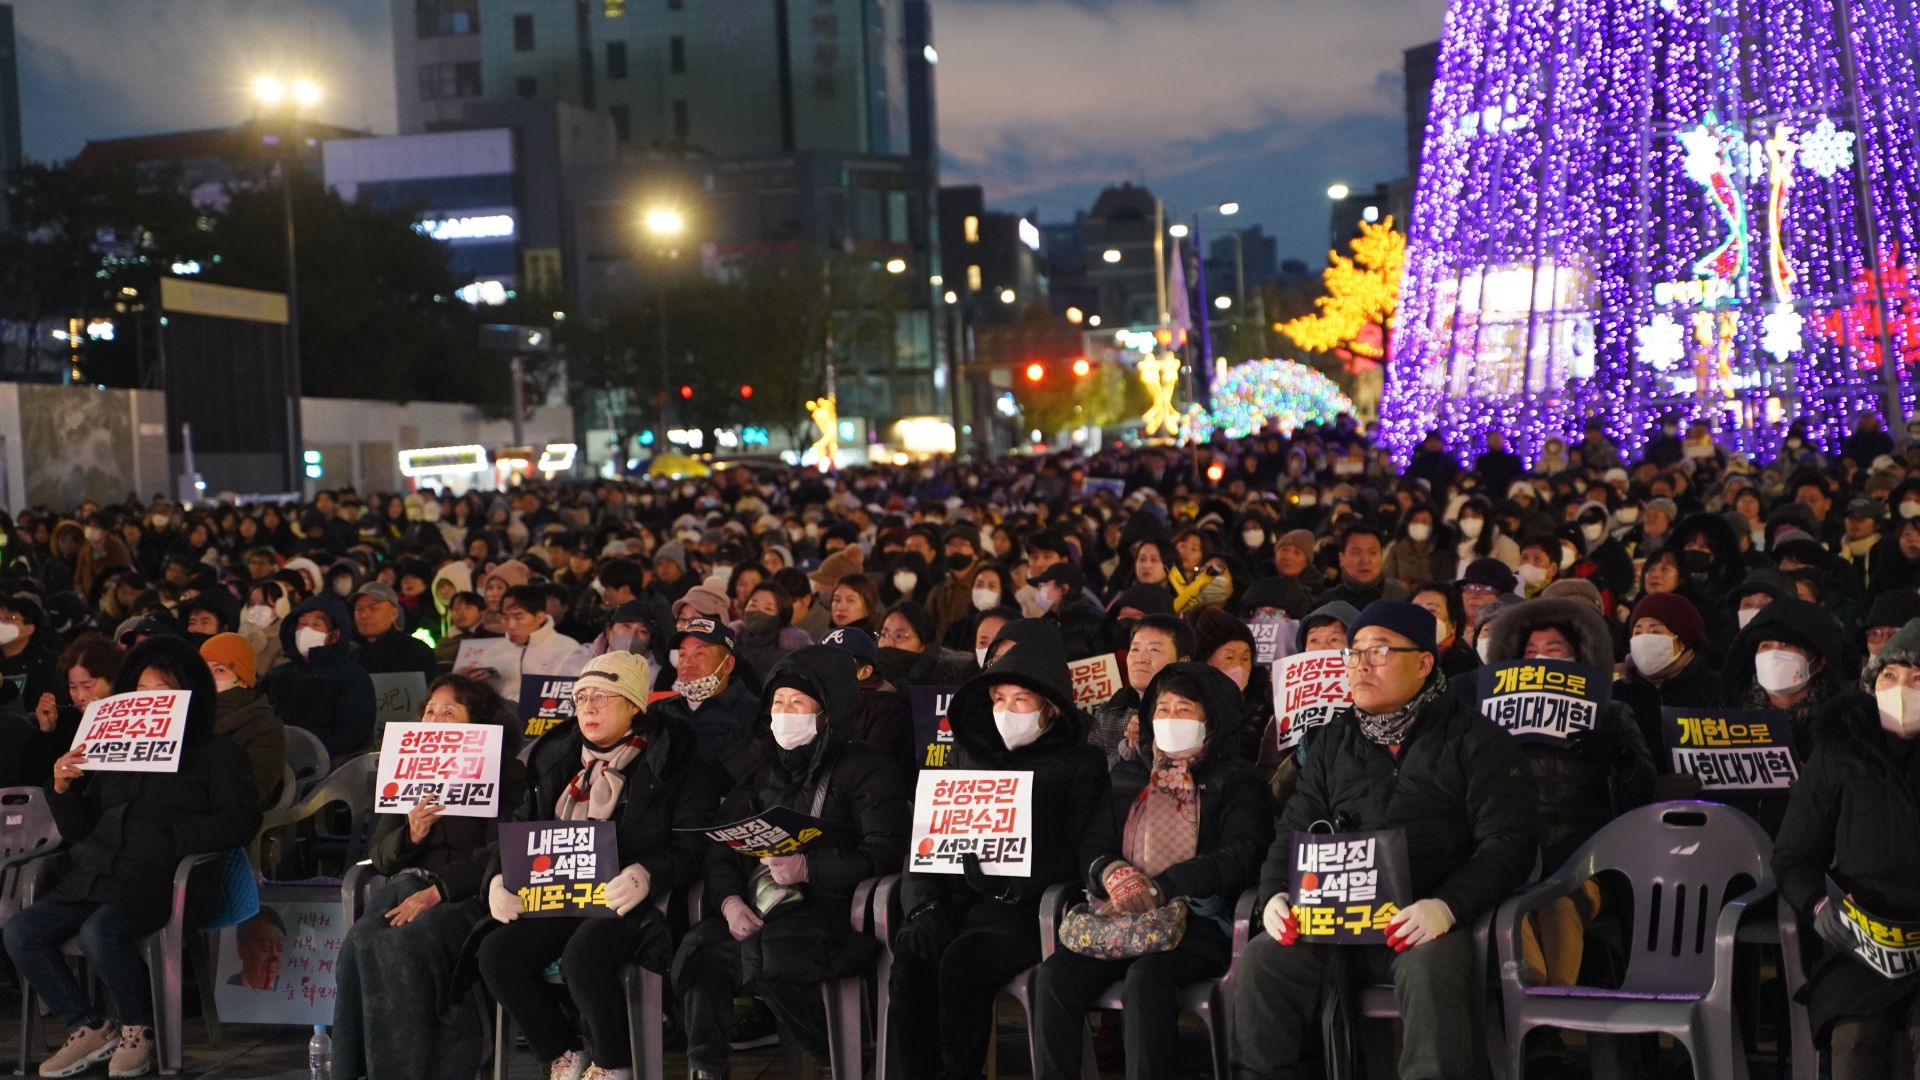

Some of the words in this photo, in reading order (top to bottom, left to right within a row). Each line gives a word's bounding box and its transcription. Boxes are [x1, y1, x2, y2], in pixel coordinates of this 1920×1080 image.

[1285, 657, 1348, 688] 헌정유
[1493, 665, 1587, 695] 개헌으로
[540, 680, 578, 699] 내란
[93, 694, 177, 721] 헌정유린
[84, 717, 172, 741] 내란수괴
[398, 730, 488, 754] 헌정유린
[1676, 717, 1773, 746] 개헌으로
[130, 740, 178, 762] 퇴진
[393, 756, 486, 780] 내란수괴
[378, 781, 445, 808] 윤석열
[443, 782, 495, 806] 퇴진
[932, 778, 1020, 806] 헌정유린
[704, 818, 773, 842] 내란죄
[929, 807, 1017, 835] 내란수괴
[527, 826, 596, 856] 내란죄
[979, 836, 1027, 864] 퇴진
[1297, 838, 1376, 872] 내란죄
[529, 853, 598, 885] 윤석열
[1300, 869, 1378, 905] 윤석열
